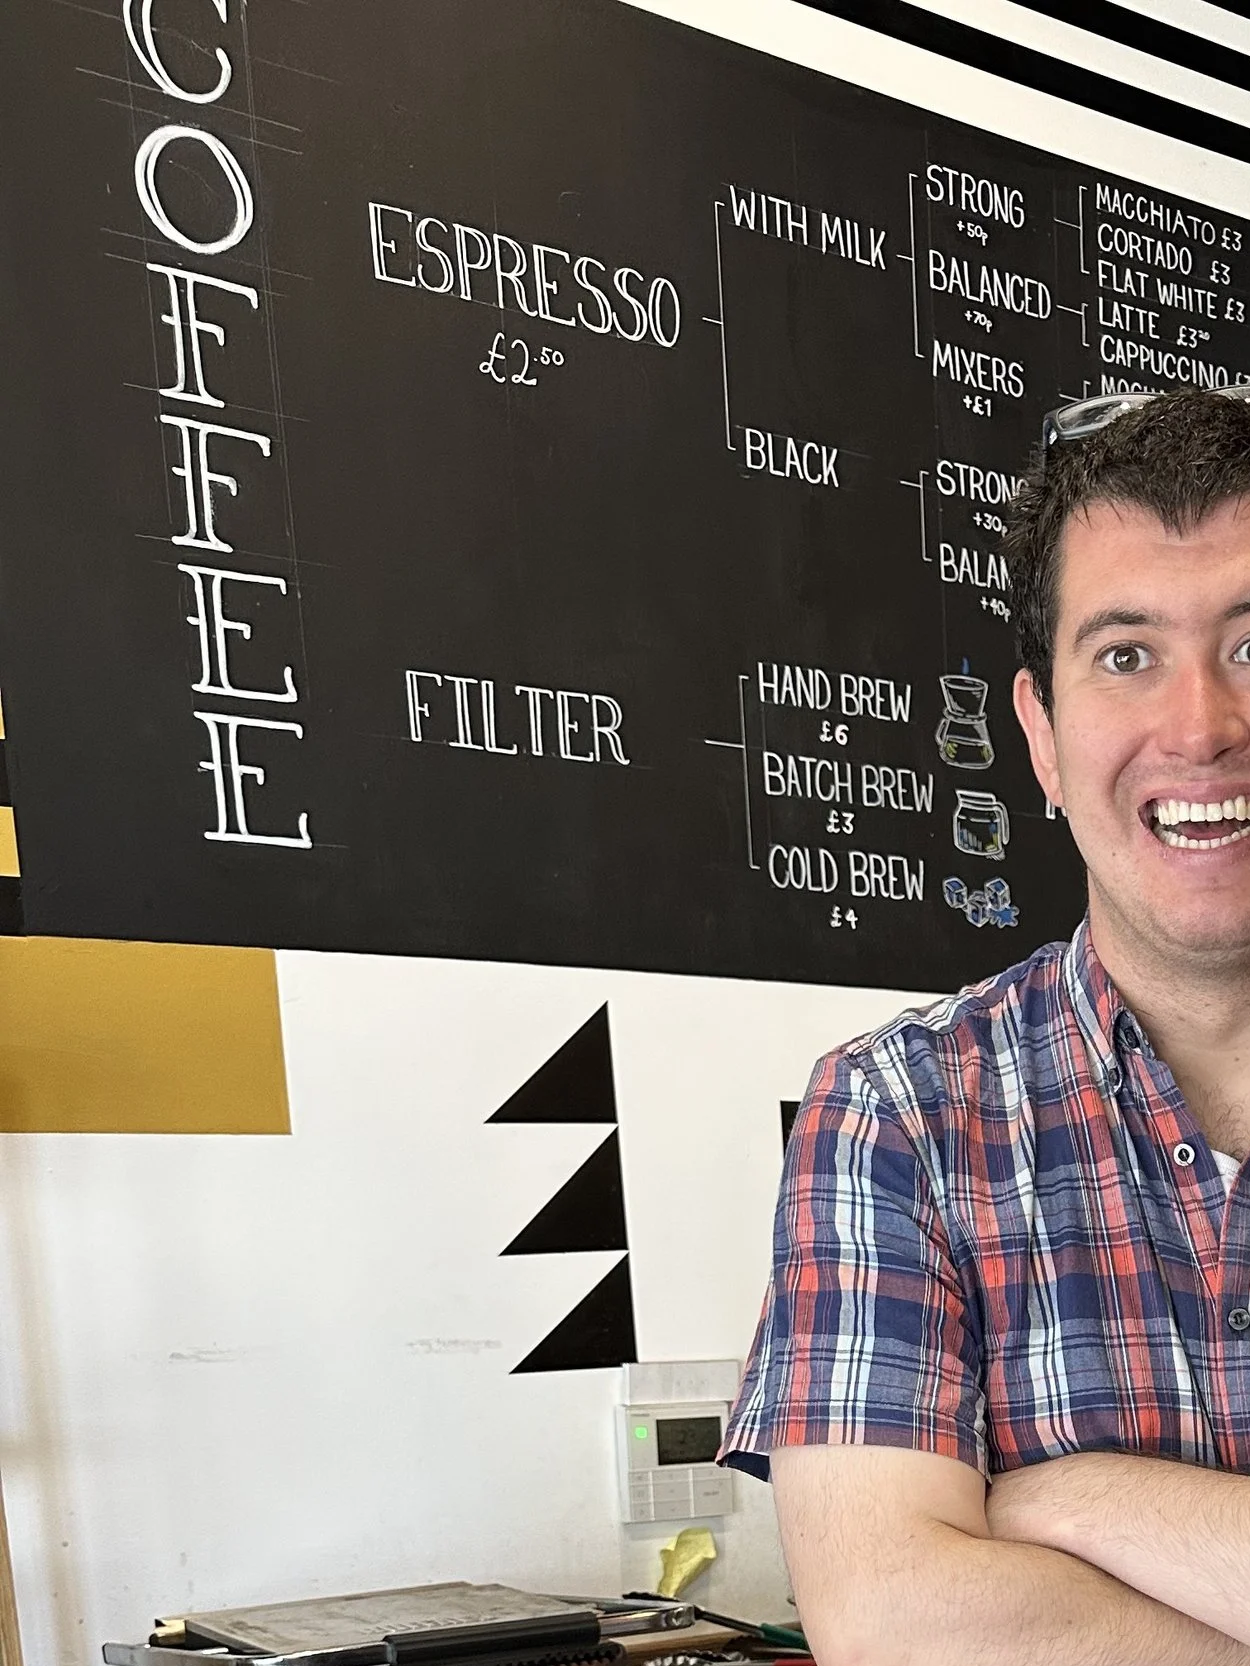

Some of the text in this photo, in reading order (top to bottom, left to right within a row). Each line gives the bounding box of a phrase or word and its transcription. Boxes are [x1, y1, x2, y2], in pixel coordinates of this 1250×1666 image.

[926, 165, 1025, 228] STRONG
[1096, 182, 1243, 251] MACCHIATO £3
[730, 185, 886, 270] WITH MILK
[957, 220, 989, 247] +50p
[1098, 223, 1231, 286] CORTADO £3
[369, 202, 681, 348] ESPRESSO
[929, 249, 1051, 320] BALANCED
[1098, 260, 1246, 323] FLAT WHITE £3
[964, 310, 993, 333] +70p
[1098, 296, 1160, 340] LATTE
[479, 332, 565, 387] £2.50
[932, 340, 1025, 399] MIXERS
[1100, 335, 1229, 391] CAPPUCCINO
[125, 0, 312, 848] COFFEE
[962, 395, 993, 418] +£1
[745, 428, 839, 488] BLACK
[973, 512, 1008, 537] +30p
[980, 596, 1011, 623] +40p
[405, 669, 630, 766] FILTER
[757, 661, 911, 723] HAND BREW
[819, 720, 849, 745] £6
[763, 751, 934, 813] BATCH BREW
[826, 810, 855, 835] £3
[768, 844, 924, 901] COLD BREW
[830, 905, 859, 930] £4
